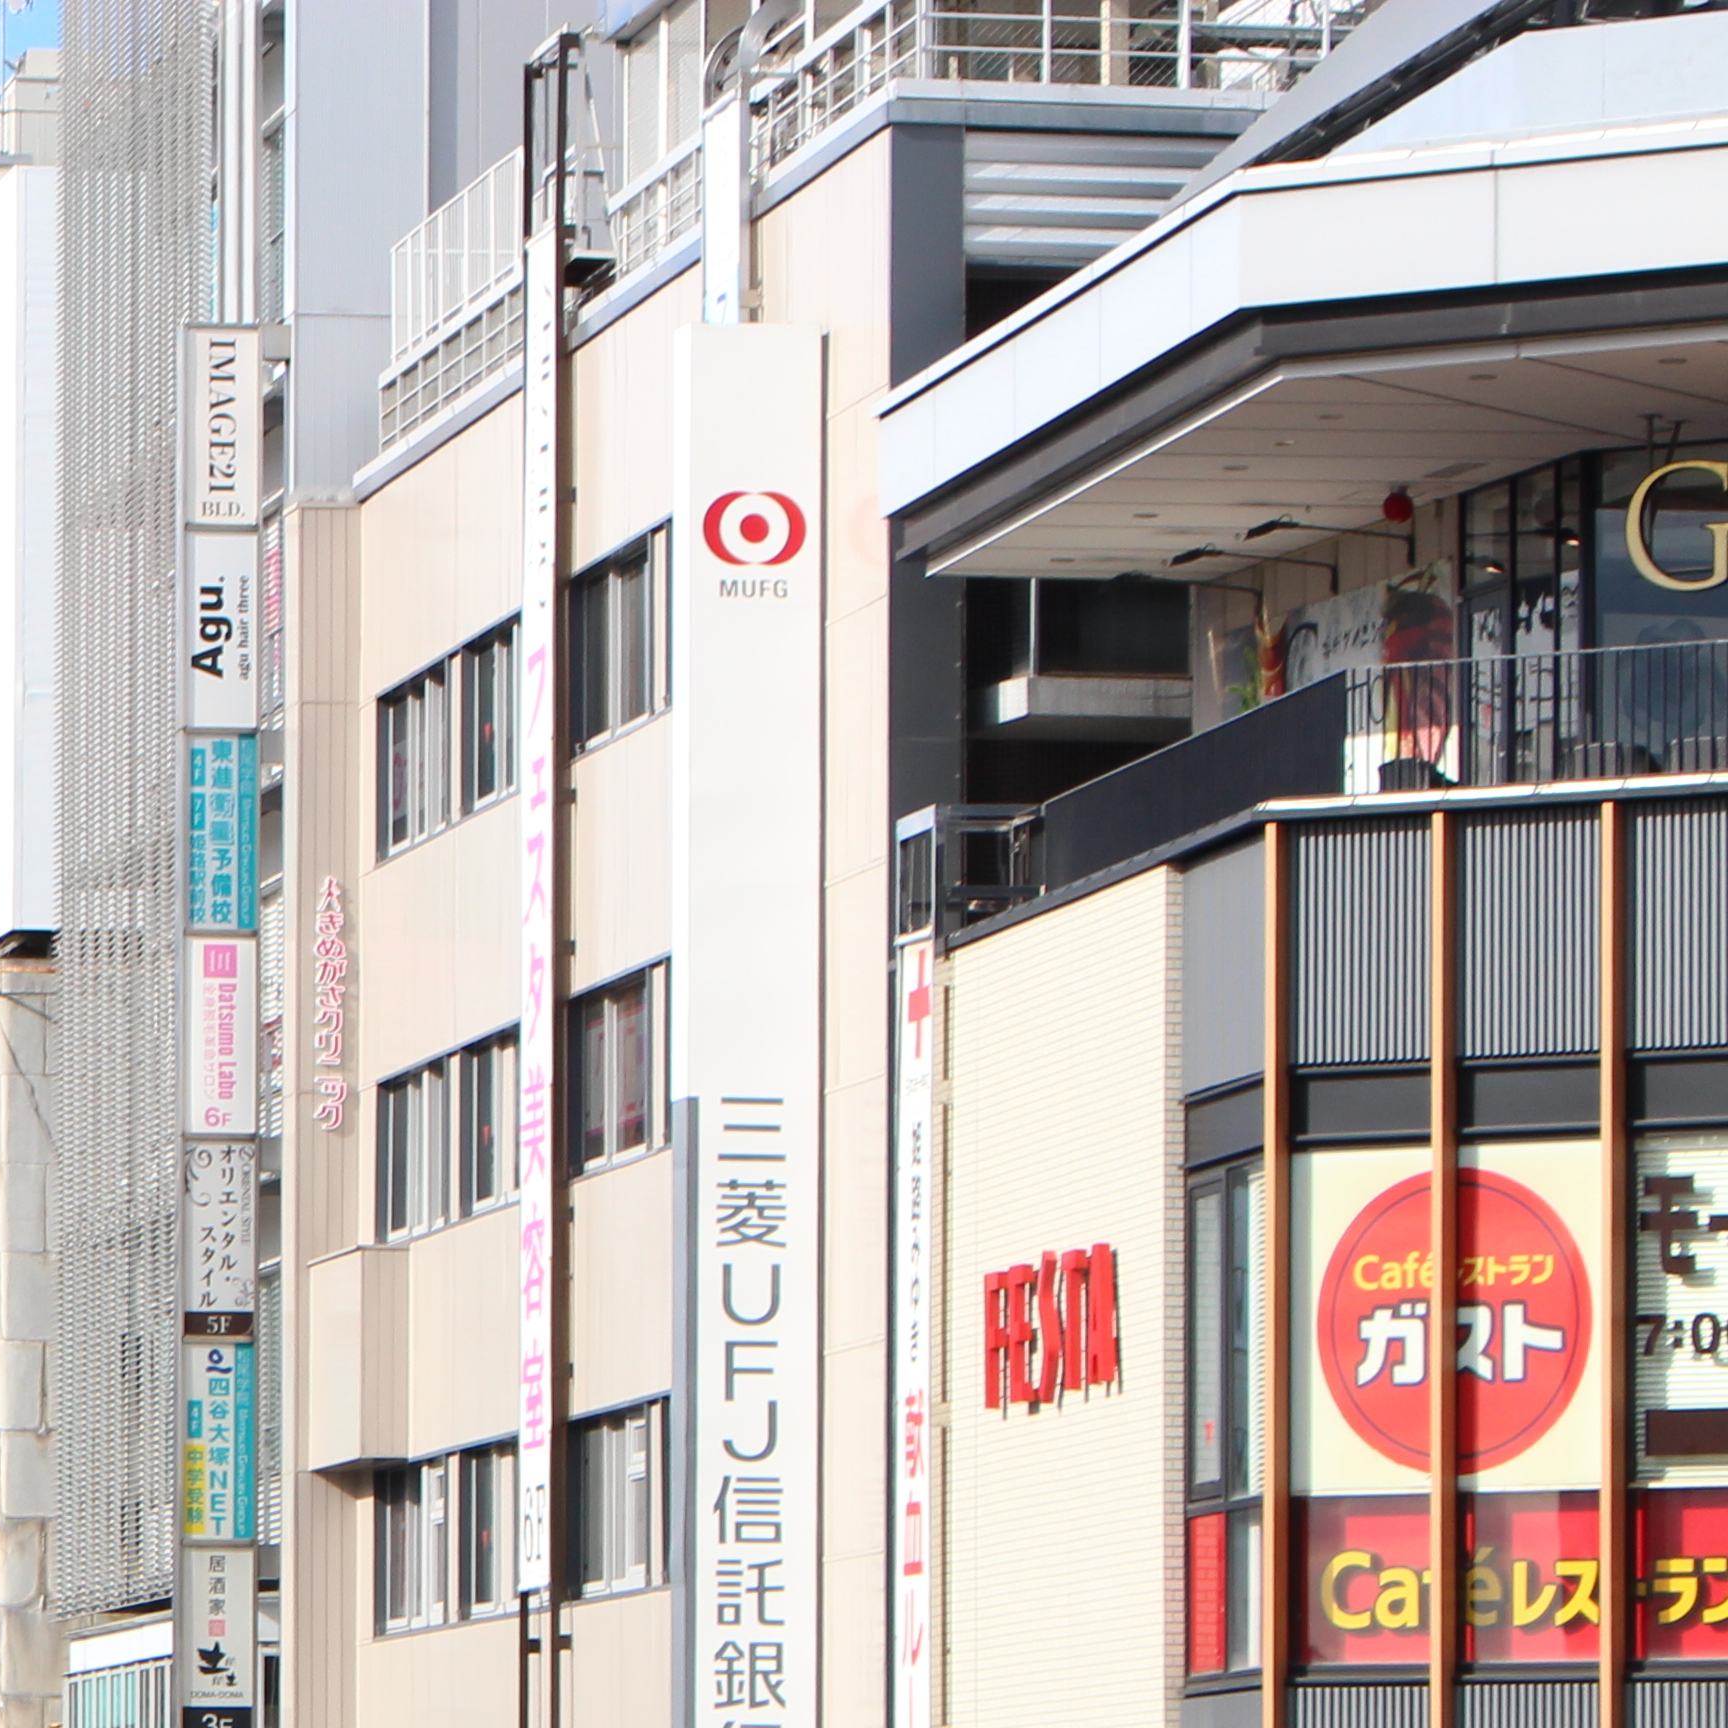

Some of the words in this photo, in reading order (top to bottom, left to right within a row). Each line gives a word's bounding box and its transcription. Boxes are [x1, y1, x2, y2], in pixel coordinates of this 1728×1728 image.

[208, 338, 237, 493] IMAGE21
[201, 501, 246, 518] BLD.
[237, 573, 250, 605] three
[719, 577, 790, 599] MUFG
[191, 574, 234, 679] Agu.
[237, 609, 250, 644] hair
[210, 739, 235, 924] 東進衛星予備校
[218, 983, 238, 1056] Datsumo
[203, 1107, 233, 1127] 6F
[218, 1062, 238, 1101] Labo
[198, 1226, 218, 1309] スタイル
[206, 1315, 233, 1334] 5F
[984, 1242, 1120, 1411] FESTA
[1355, 1299, 1565, 1387] ガスト
[186, 1447, 204, 1526] 中学受験
[208, 1376, 231, 1536] 四谷大塚NET
